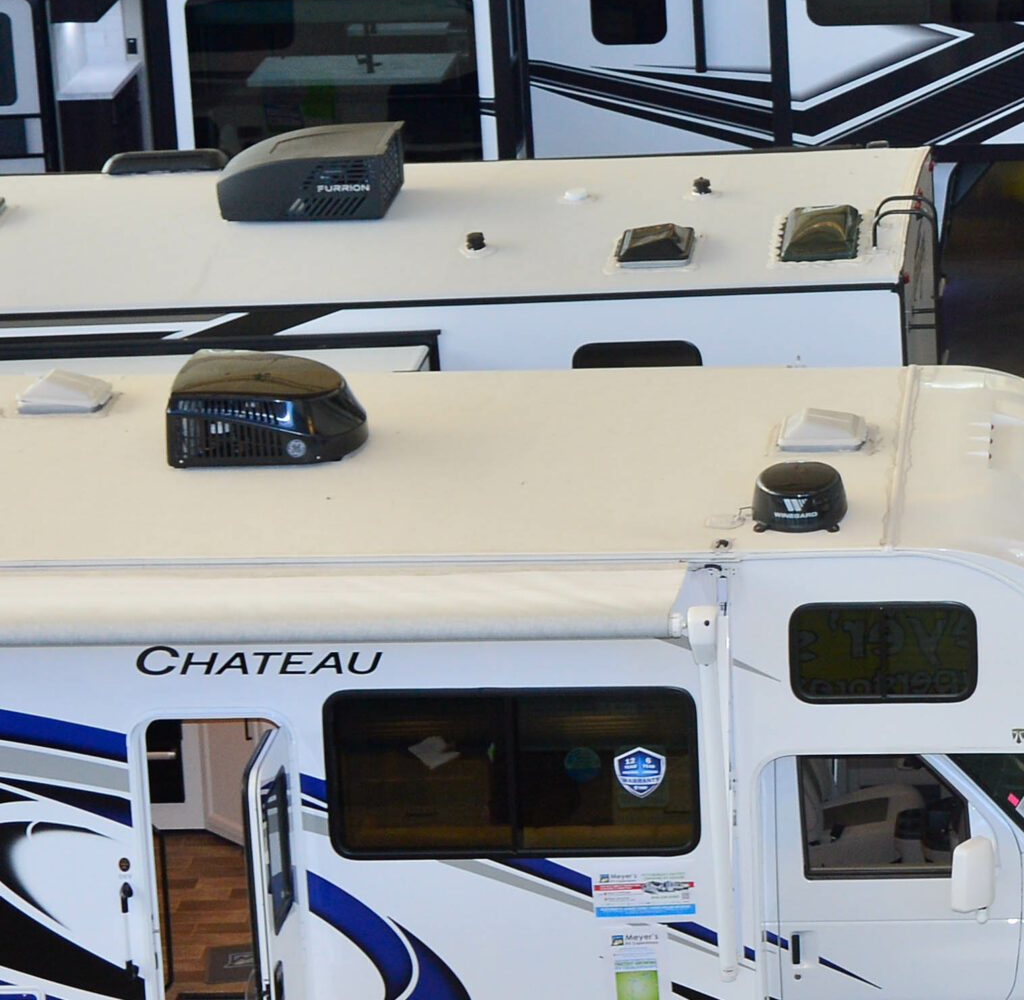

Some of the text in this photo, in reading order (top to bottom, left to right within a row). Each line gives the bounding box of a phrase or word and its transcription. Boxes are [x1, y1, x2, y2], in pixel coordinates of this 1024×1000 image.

[317, 184, 371, 193] FURRION
[773, 511, 819, 519] WINEGARD
[136, 645, 382, 676] CHATEAU
